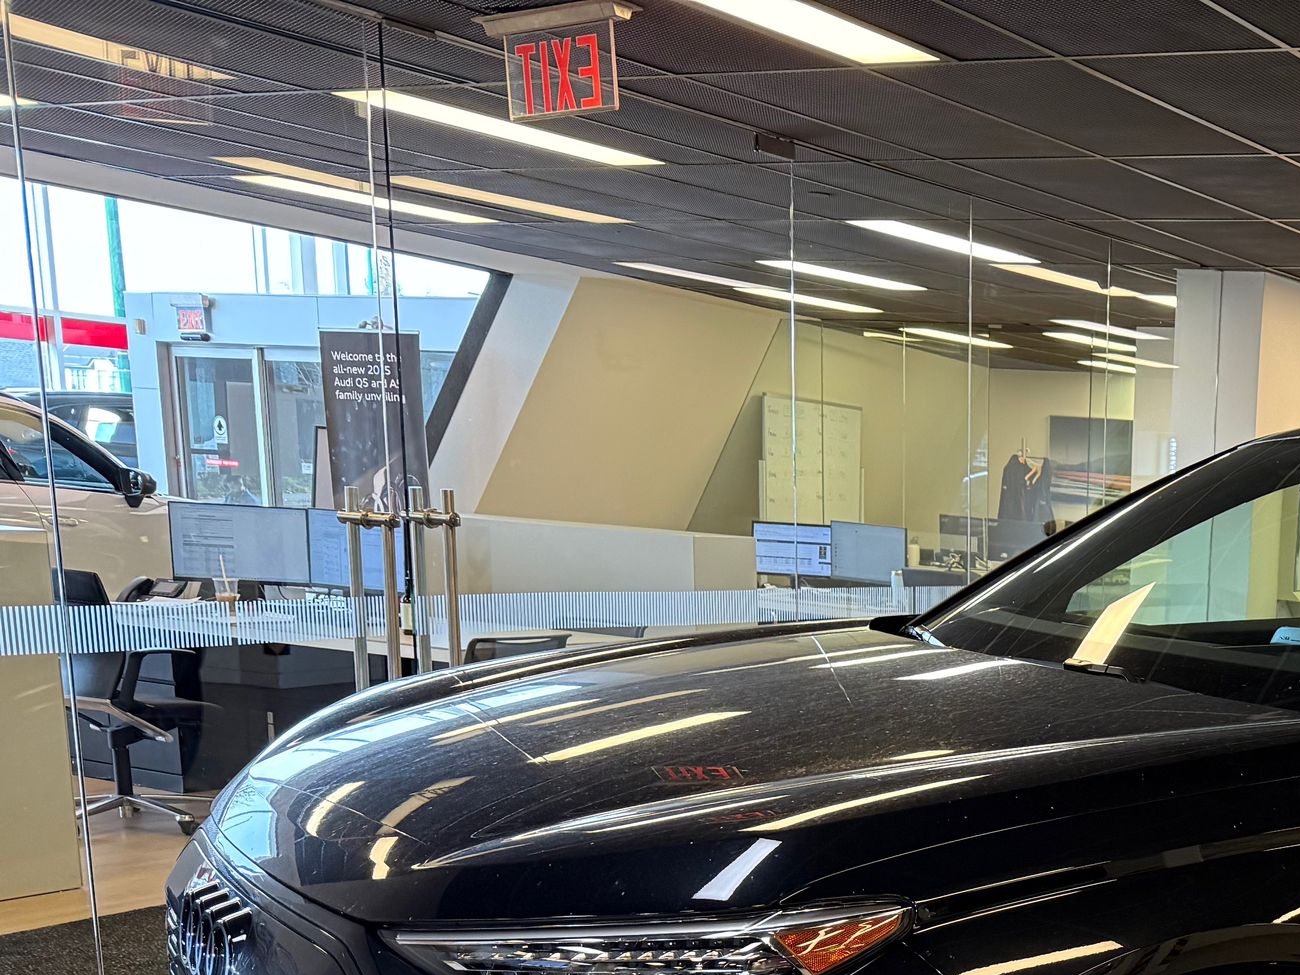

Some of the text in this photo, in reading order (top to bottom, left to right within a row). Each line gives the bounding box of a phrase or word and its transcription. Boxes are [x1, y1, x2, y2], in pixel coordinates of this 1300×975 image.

[331, 351, 373, 361] Welcome
[386, 353, 401, 362] th
[333, 364, 391, 375] all-new 205
[334, 377, 354, 387] Audi
[355, 378, 369, 388] Q5
[335, 390, 406, 404] family unvilin
